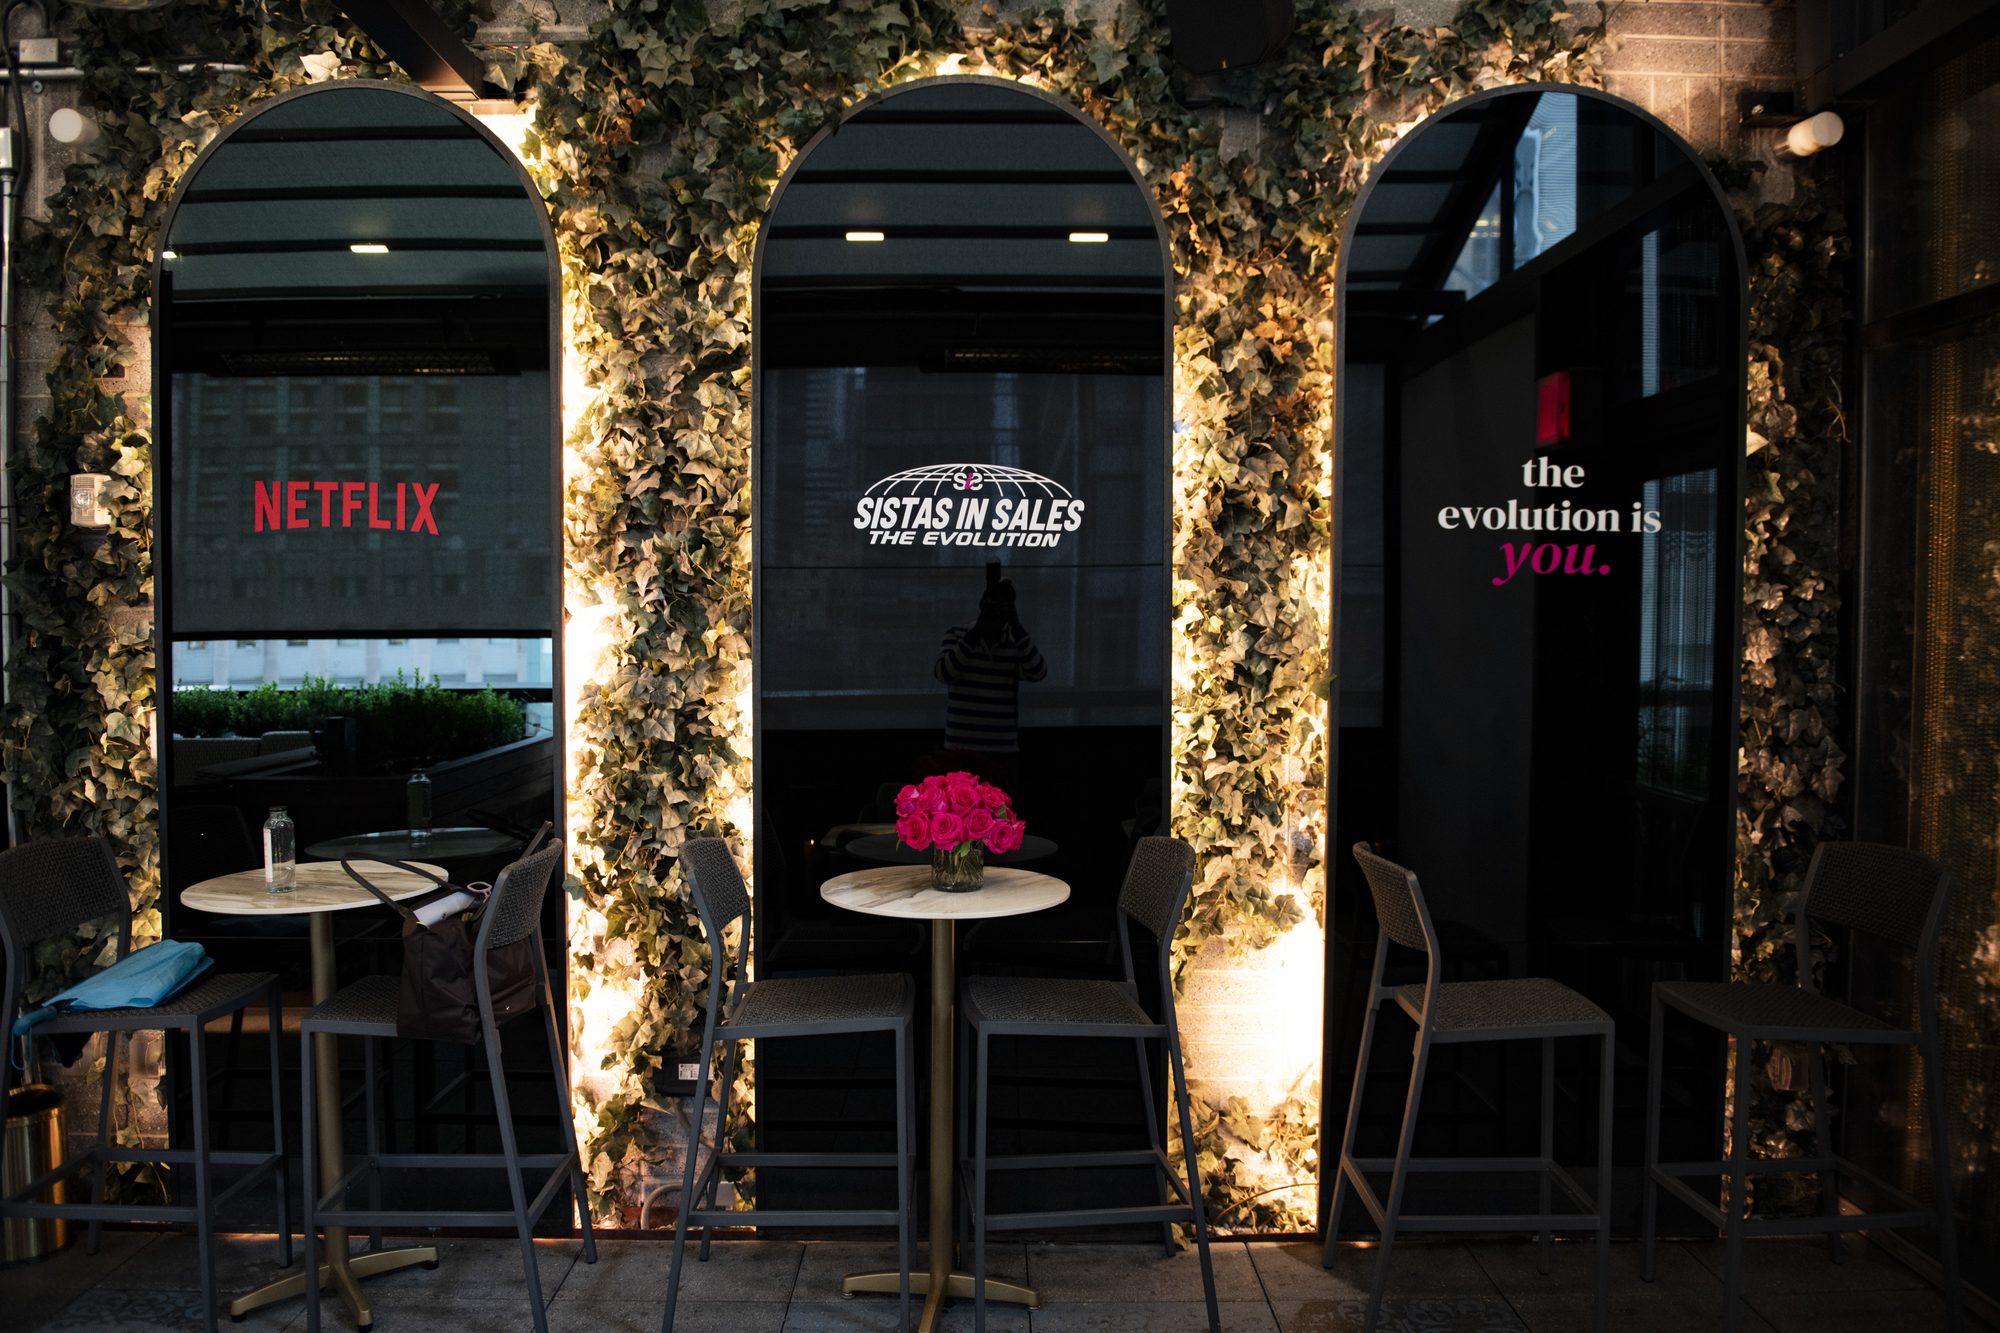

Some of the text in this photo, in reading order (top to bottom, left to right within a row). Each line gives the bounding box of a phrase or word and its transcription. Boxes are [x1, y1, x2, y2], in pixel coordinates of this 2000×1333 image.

[1522, 456, 1585, 488] the
[254, 480, 440, 535] NETFLIX
[854, 497, 1085, 532] SISTAS IN SALES
[1437, 499, 1662, 533] evolution is
[869, 531, 1061, 547] THE EVOLUTION
[1491, 542, 1611, 586] you.
